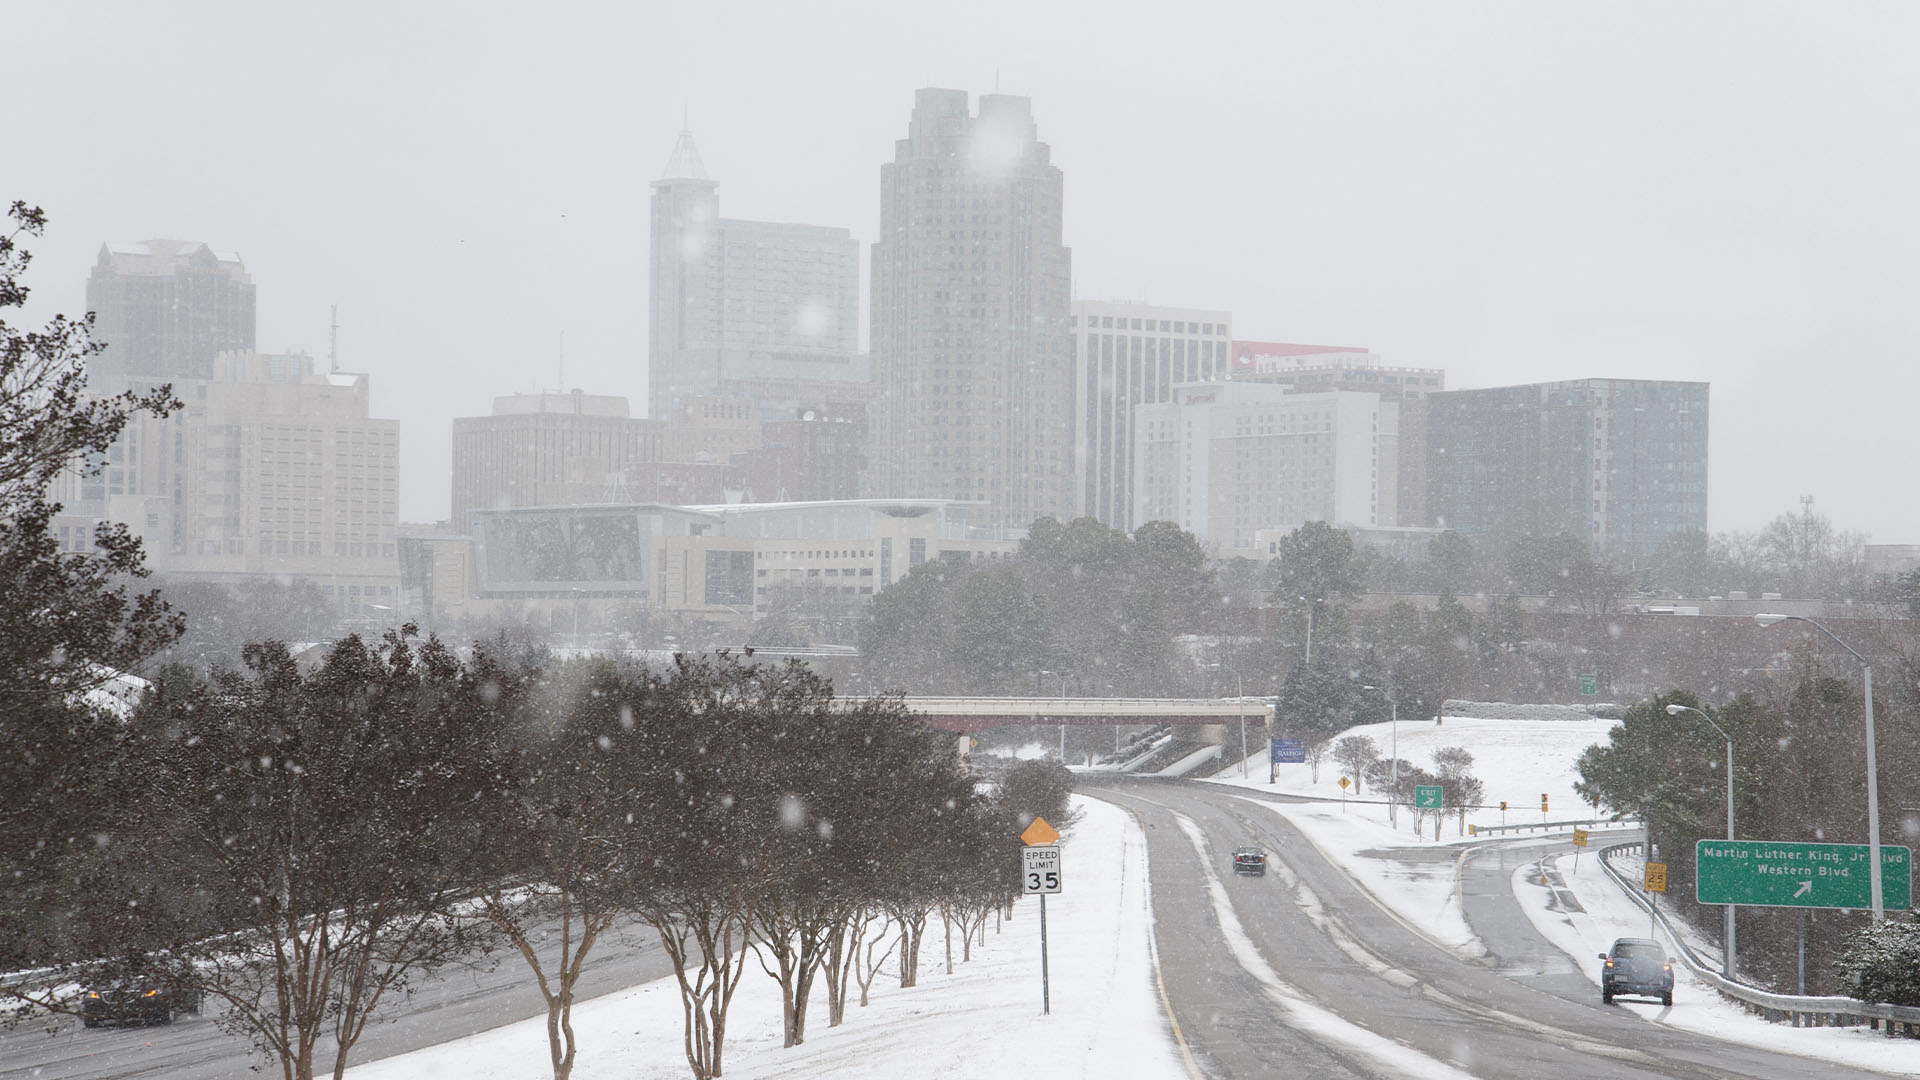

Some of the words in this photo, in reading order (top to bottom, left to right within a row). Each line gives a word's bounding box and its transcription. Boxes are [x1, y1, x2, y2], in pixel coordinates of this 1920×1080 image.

[1026, 851, 1057, 859] SPEED
[1703, 847, 1749, 859] Martin
[1755, 848, 1801, 860] Luther
[1850, 851, 1865, 862] Jr
[1029, 861, 1054, 869] LIMIT
[1757, 864, 1812, 876] Western
[1818, 866, 1849, 877] Blvd
[1028, 872, 1058, 890] 35
[1648, 873, 1663, 883] 25
